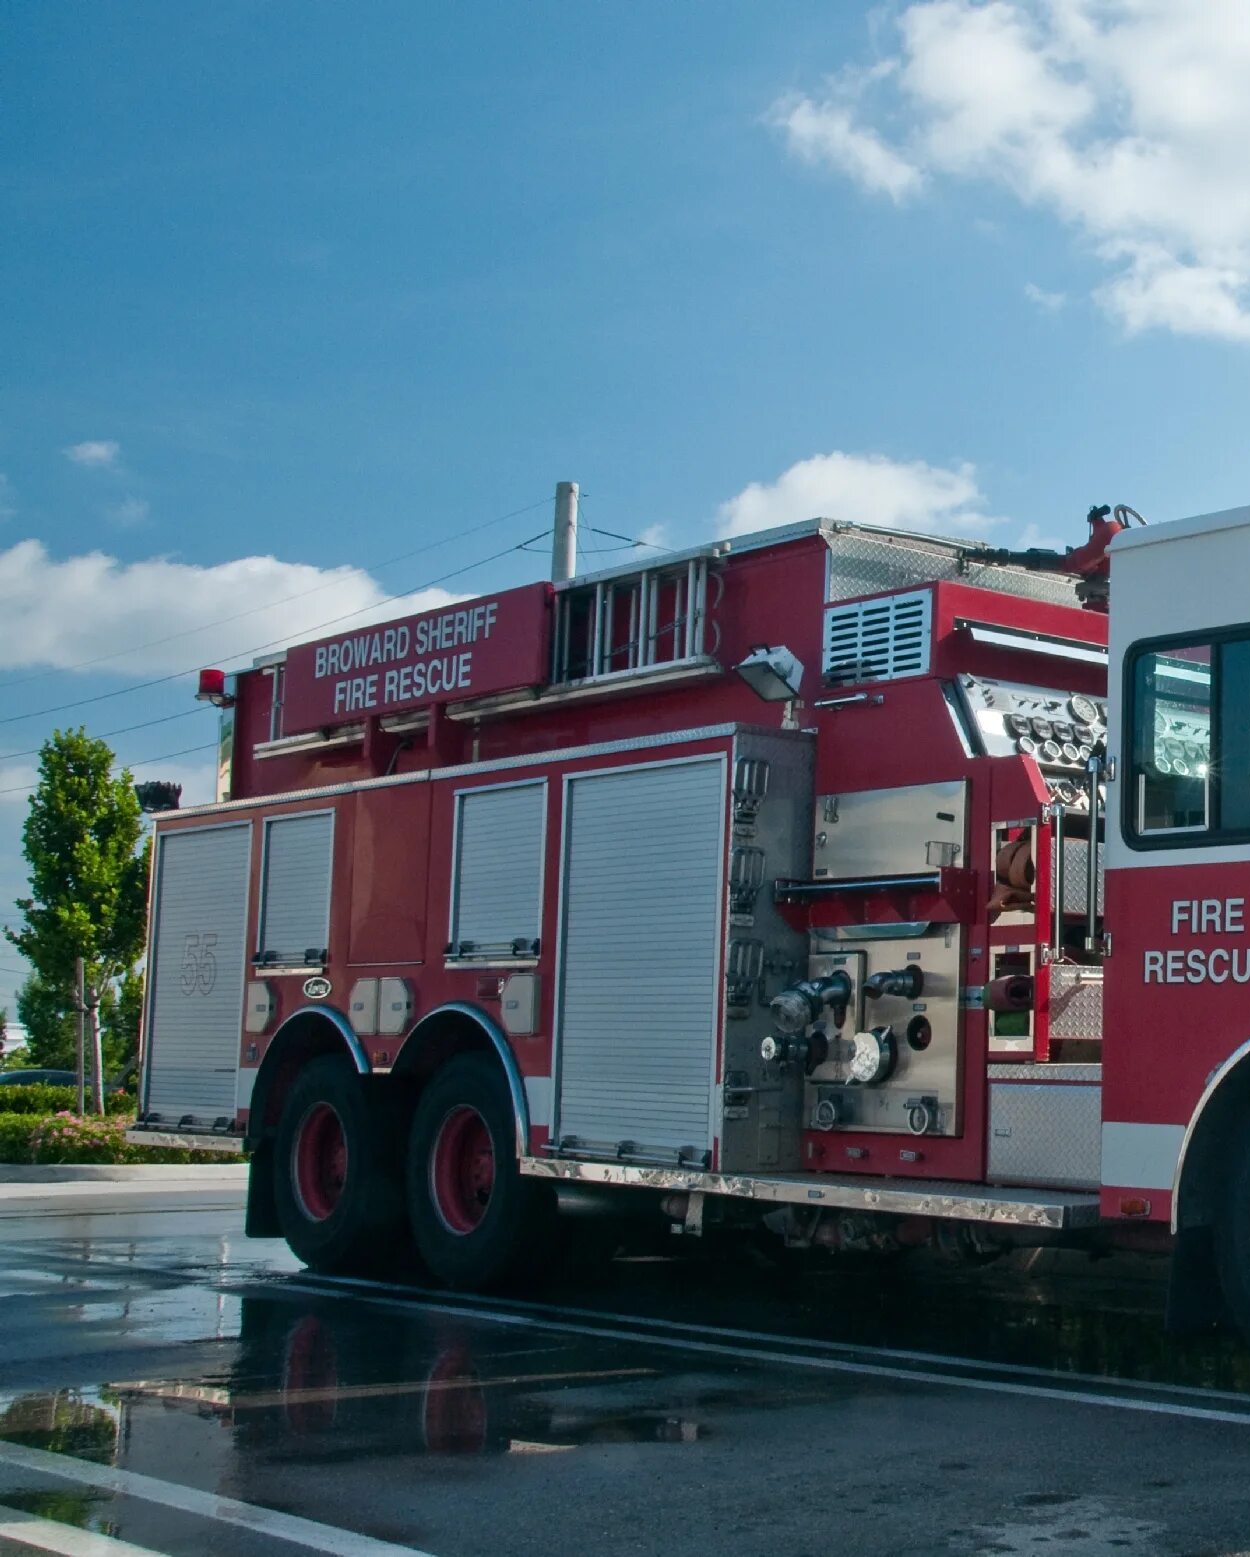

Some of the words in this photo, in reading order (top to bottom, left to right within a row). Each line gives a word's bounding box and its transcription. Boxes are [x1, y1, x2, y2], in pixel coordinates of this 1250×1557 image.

[315, 626, 410, 679] BROWARD
[415, 603, 498, 655] SHERIFF
[334, 675, 378, 714] FIRE
[385, 652, 472, 701] RESCUE
[1171, 898, 1245, 934] FIRE
